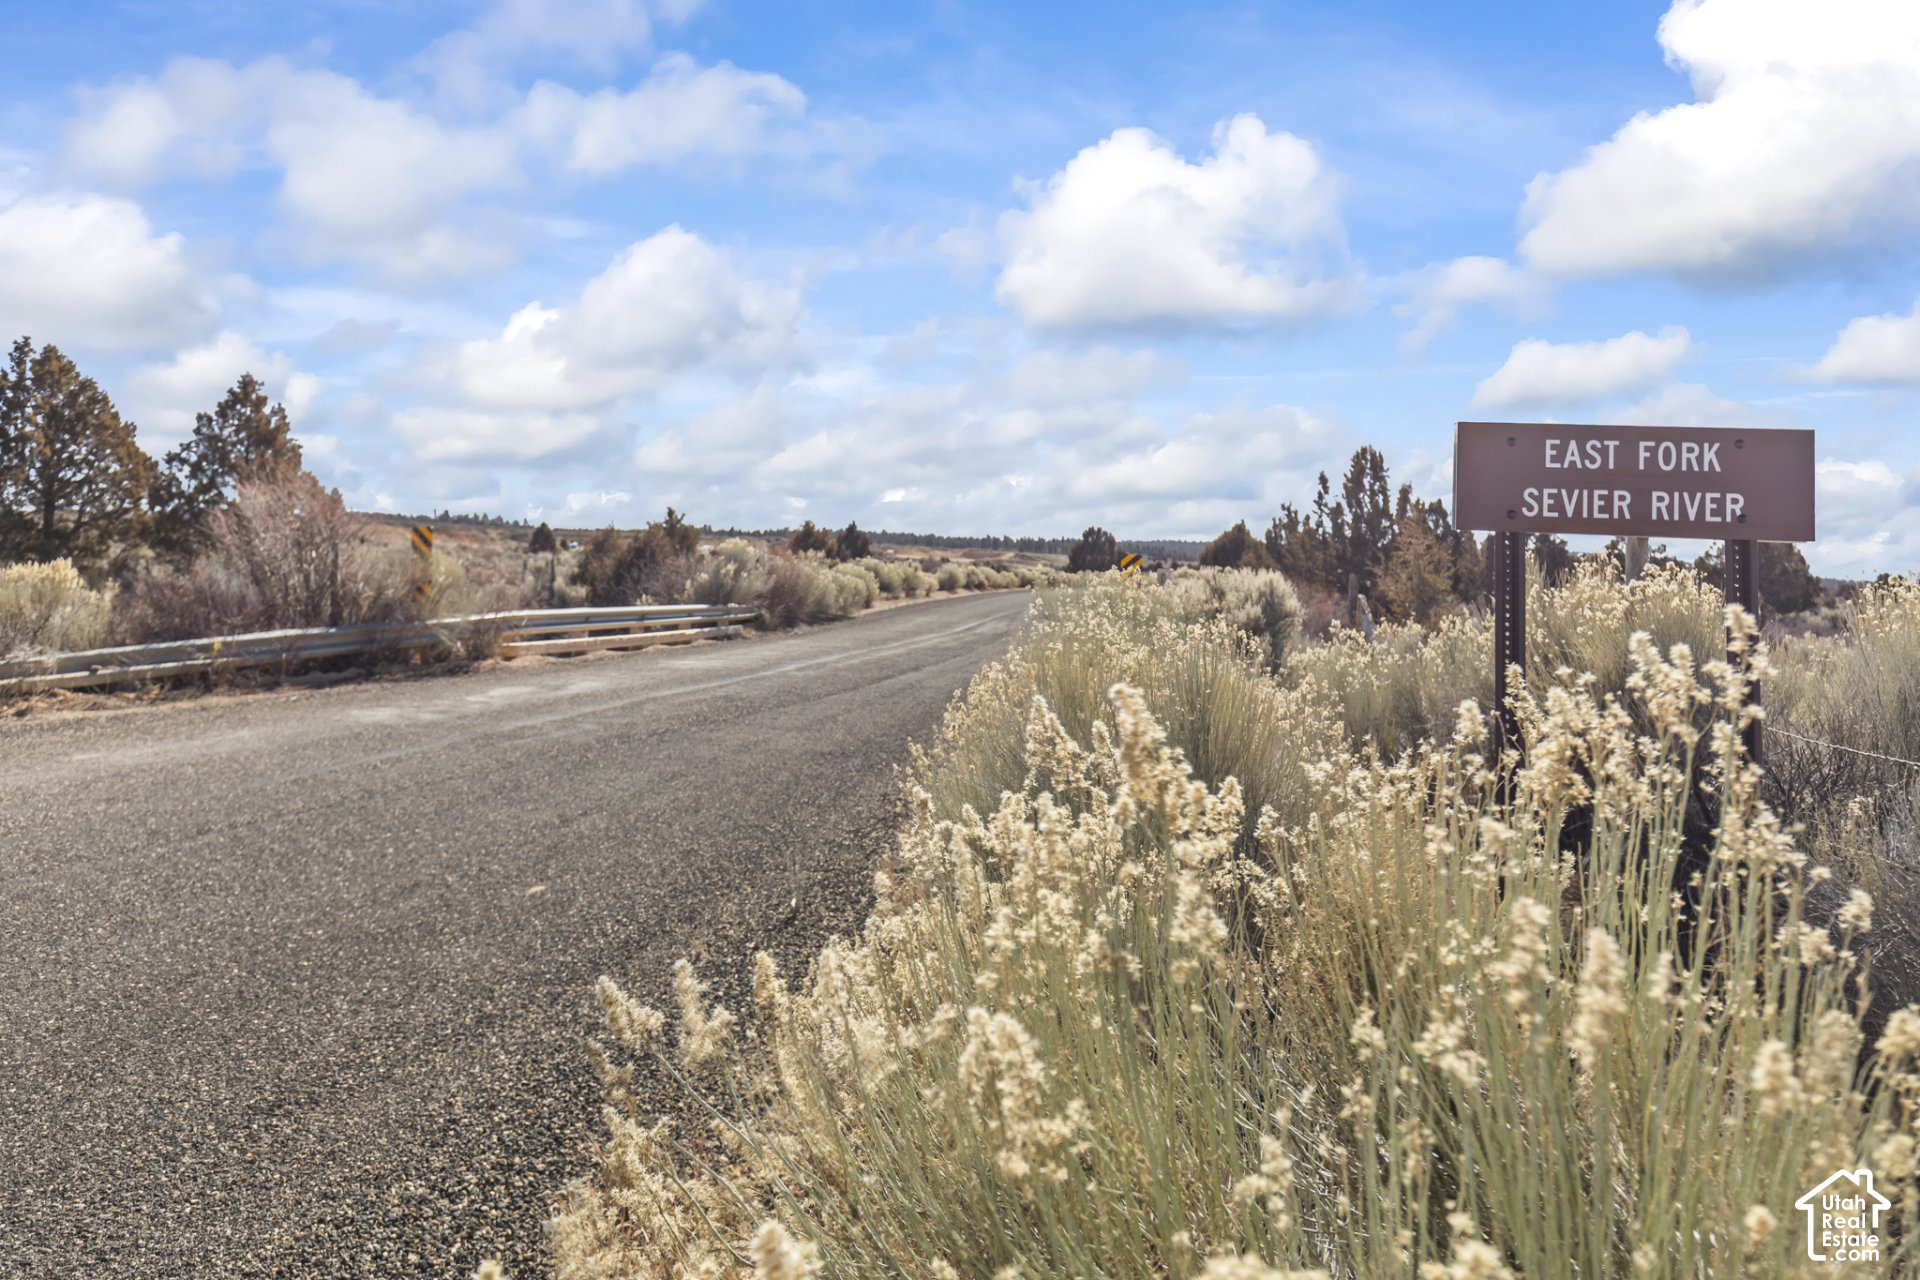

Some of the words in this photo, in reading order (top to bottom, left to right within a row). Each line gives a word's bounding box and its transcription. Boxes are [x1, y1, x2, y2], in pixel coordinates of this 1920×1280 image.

[1545, 439, 1619, 470] EAST
[1638, 441, 1721, 472] FORK
[1521, 487, 1631, 520] SEVIER
[1651, 491, 1745, 523] RIVER
